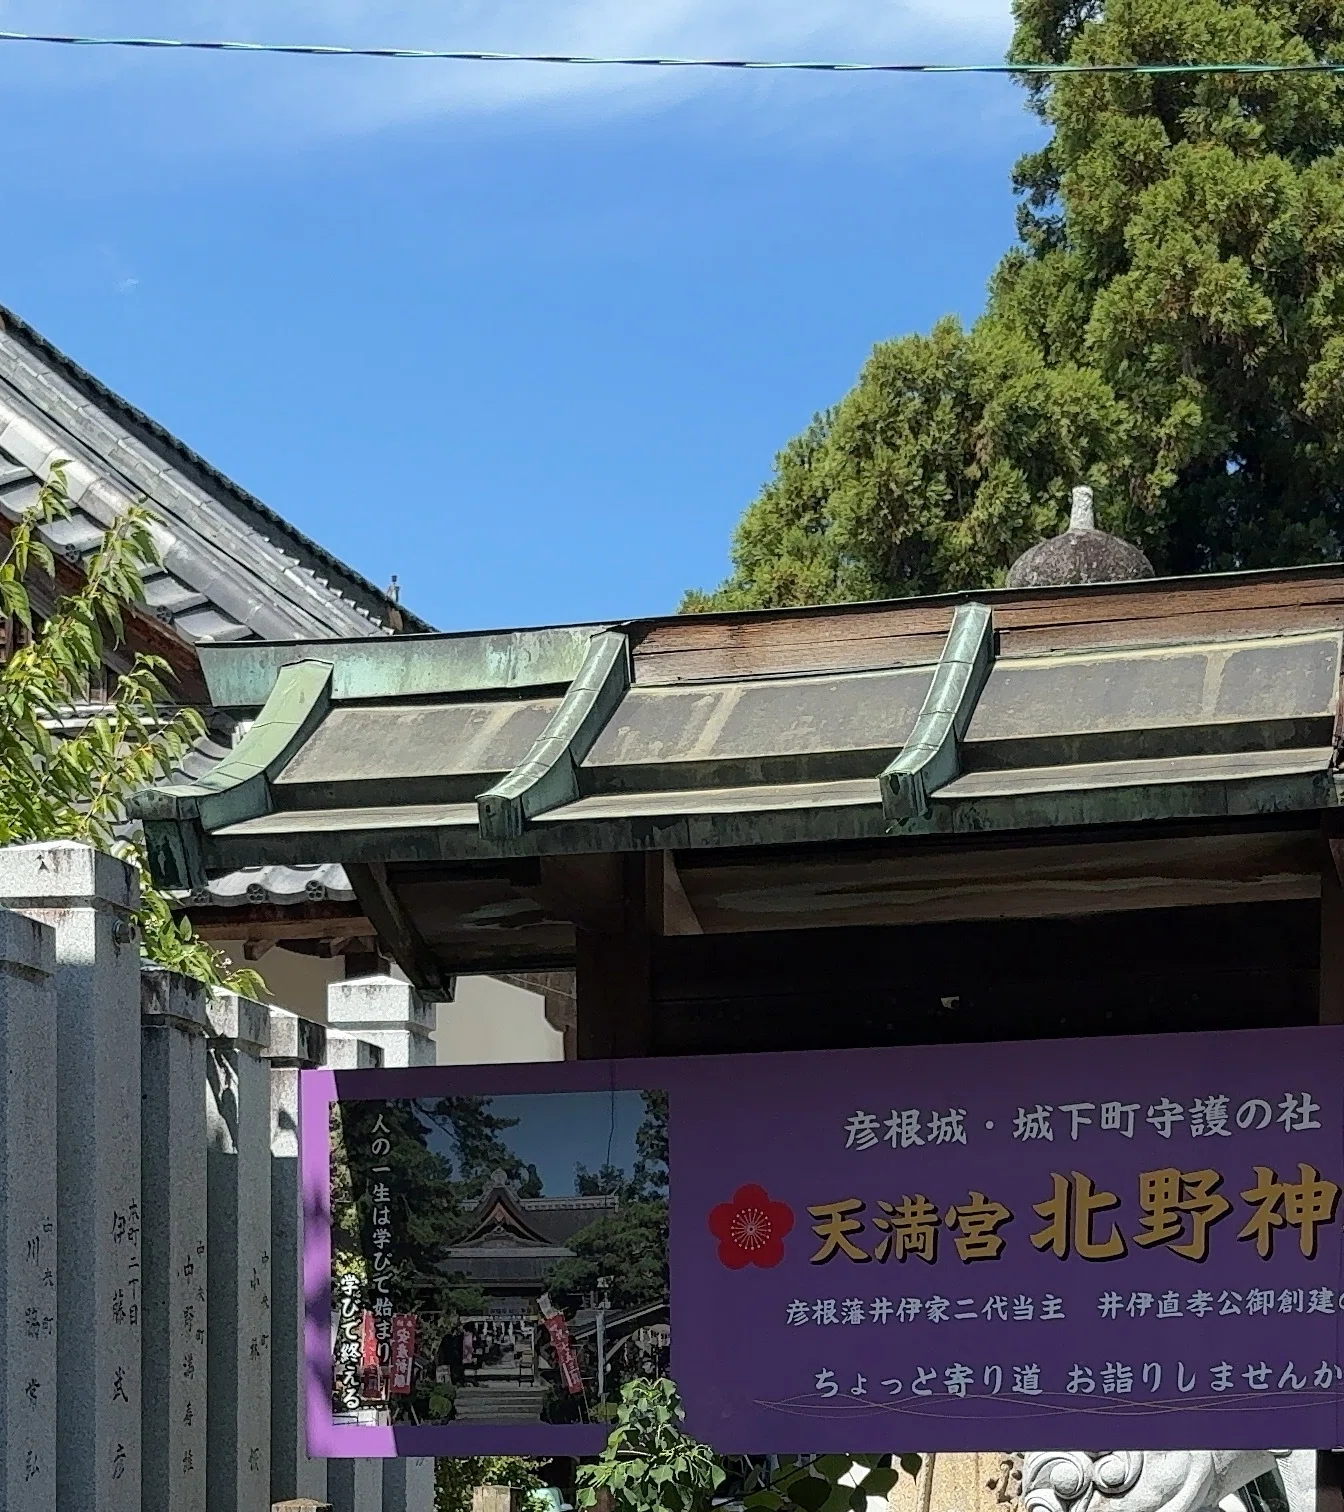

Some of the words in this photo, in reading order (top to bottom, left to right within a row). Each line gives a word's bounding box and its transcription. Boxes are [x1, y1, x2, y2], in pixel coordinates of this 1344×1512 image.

[843, 1092, 1323, 1151] 彦根城・城下町守護の社
[370, 1112, 394, 1364] 人の一生は学びて始まり
[805, 1192, 1016, 1266] 天満宮
[339, 1273, 362, 1410] 学びて終える
[814, 1361, 1044, 1398] ちょっと寄り道
[1065, 1361, 1344, 1395] お詣りしませんか
